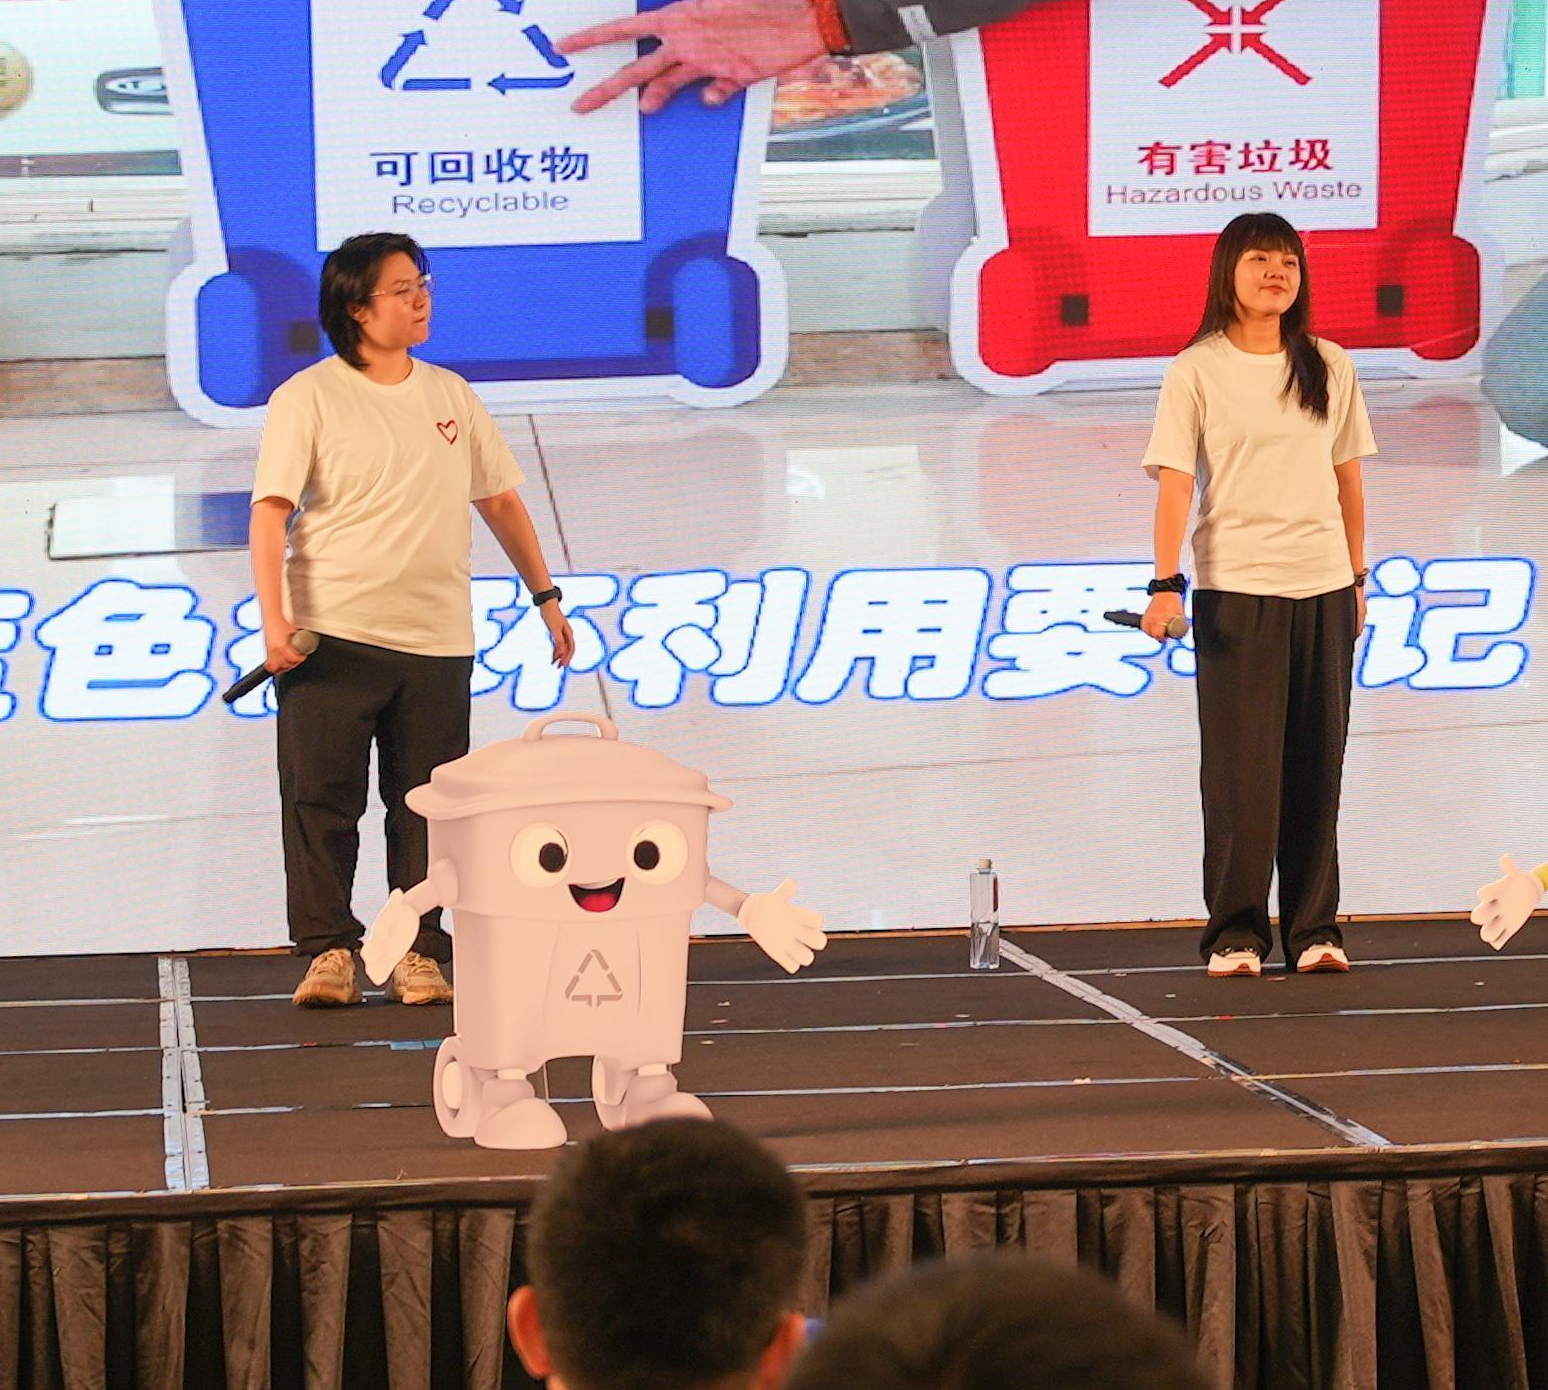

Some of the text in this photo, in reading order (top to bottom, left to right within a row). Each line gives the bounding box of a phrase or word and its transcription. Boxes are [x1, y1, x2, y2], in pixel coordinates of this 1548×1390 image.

[369, 146, 590, 188] 可回收物
[1137, 138, 1334, 177] 有害垃圾
[391, 191, 570, 219] Recyclable
[1105, 179, 1363, 207] Hazardous Waste
